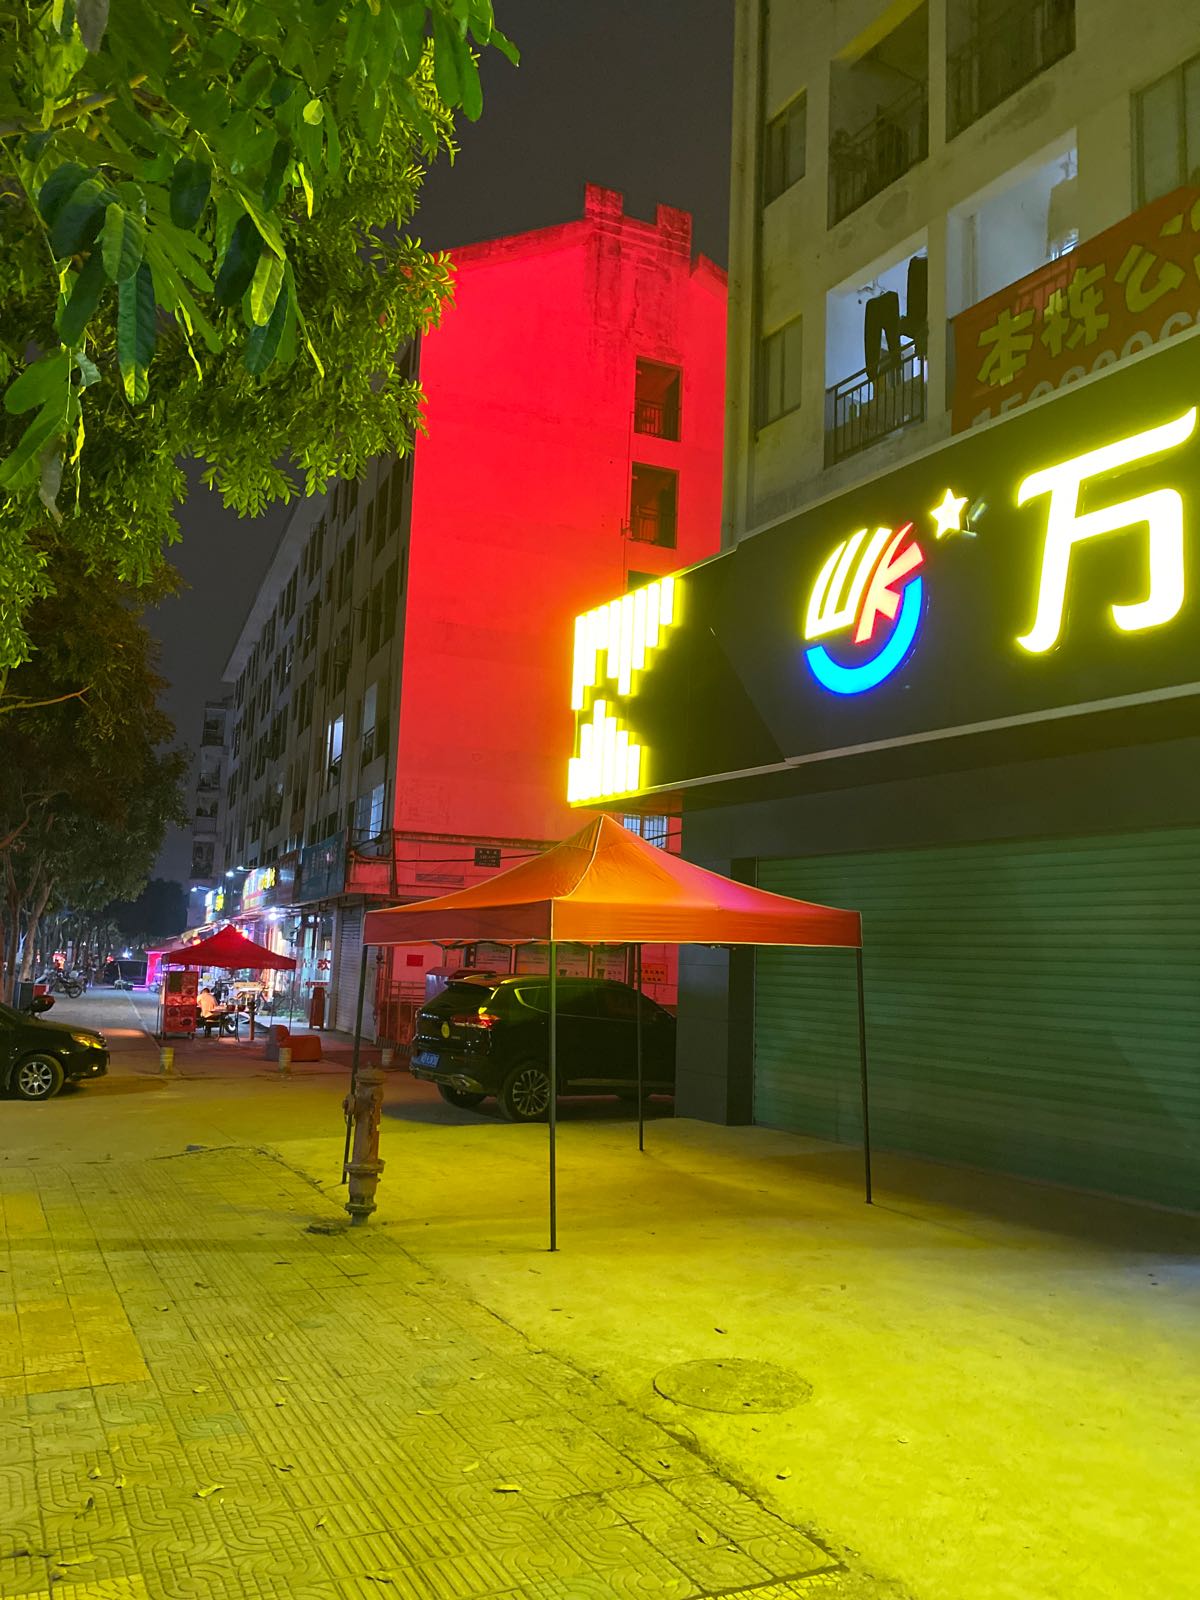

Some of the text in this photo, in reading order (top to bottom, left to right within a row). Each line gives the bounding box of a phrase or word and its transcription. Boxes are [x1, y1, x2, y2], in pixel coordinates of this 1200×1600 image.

[977, 198, 1200, 387] 本栋公
[1016, 405, 1197, 653] 万
